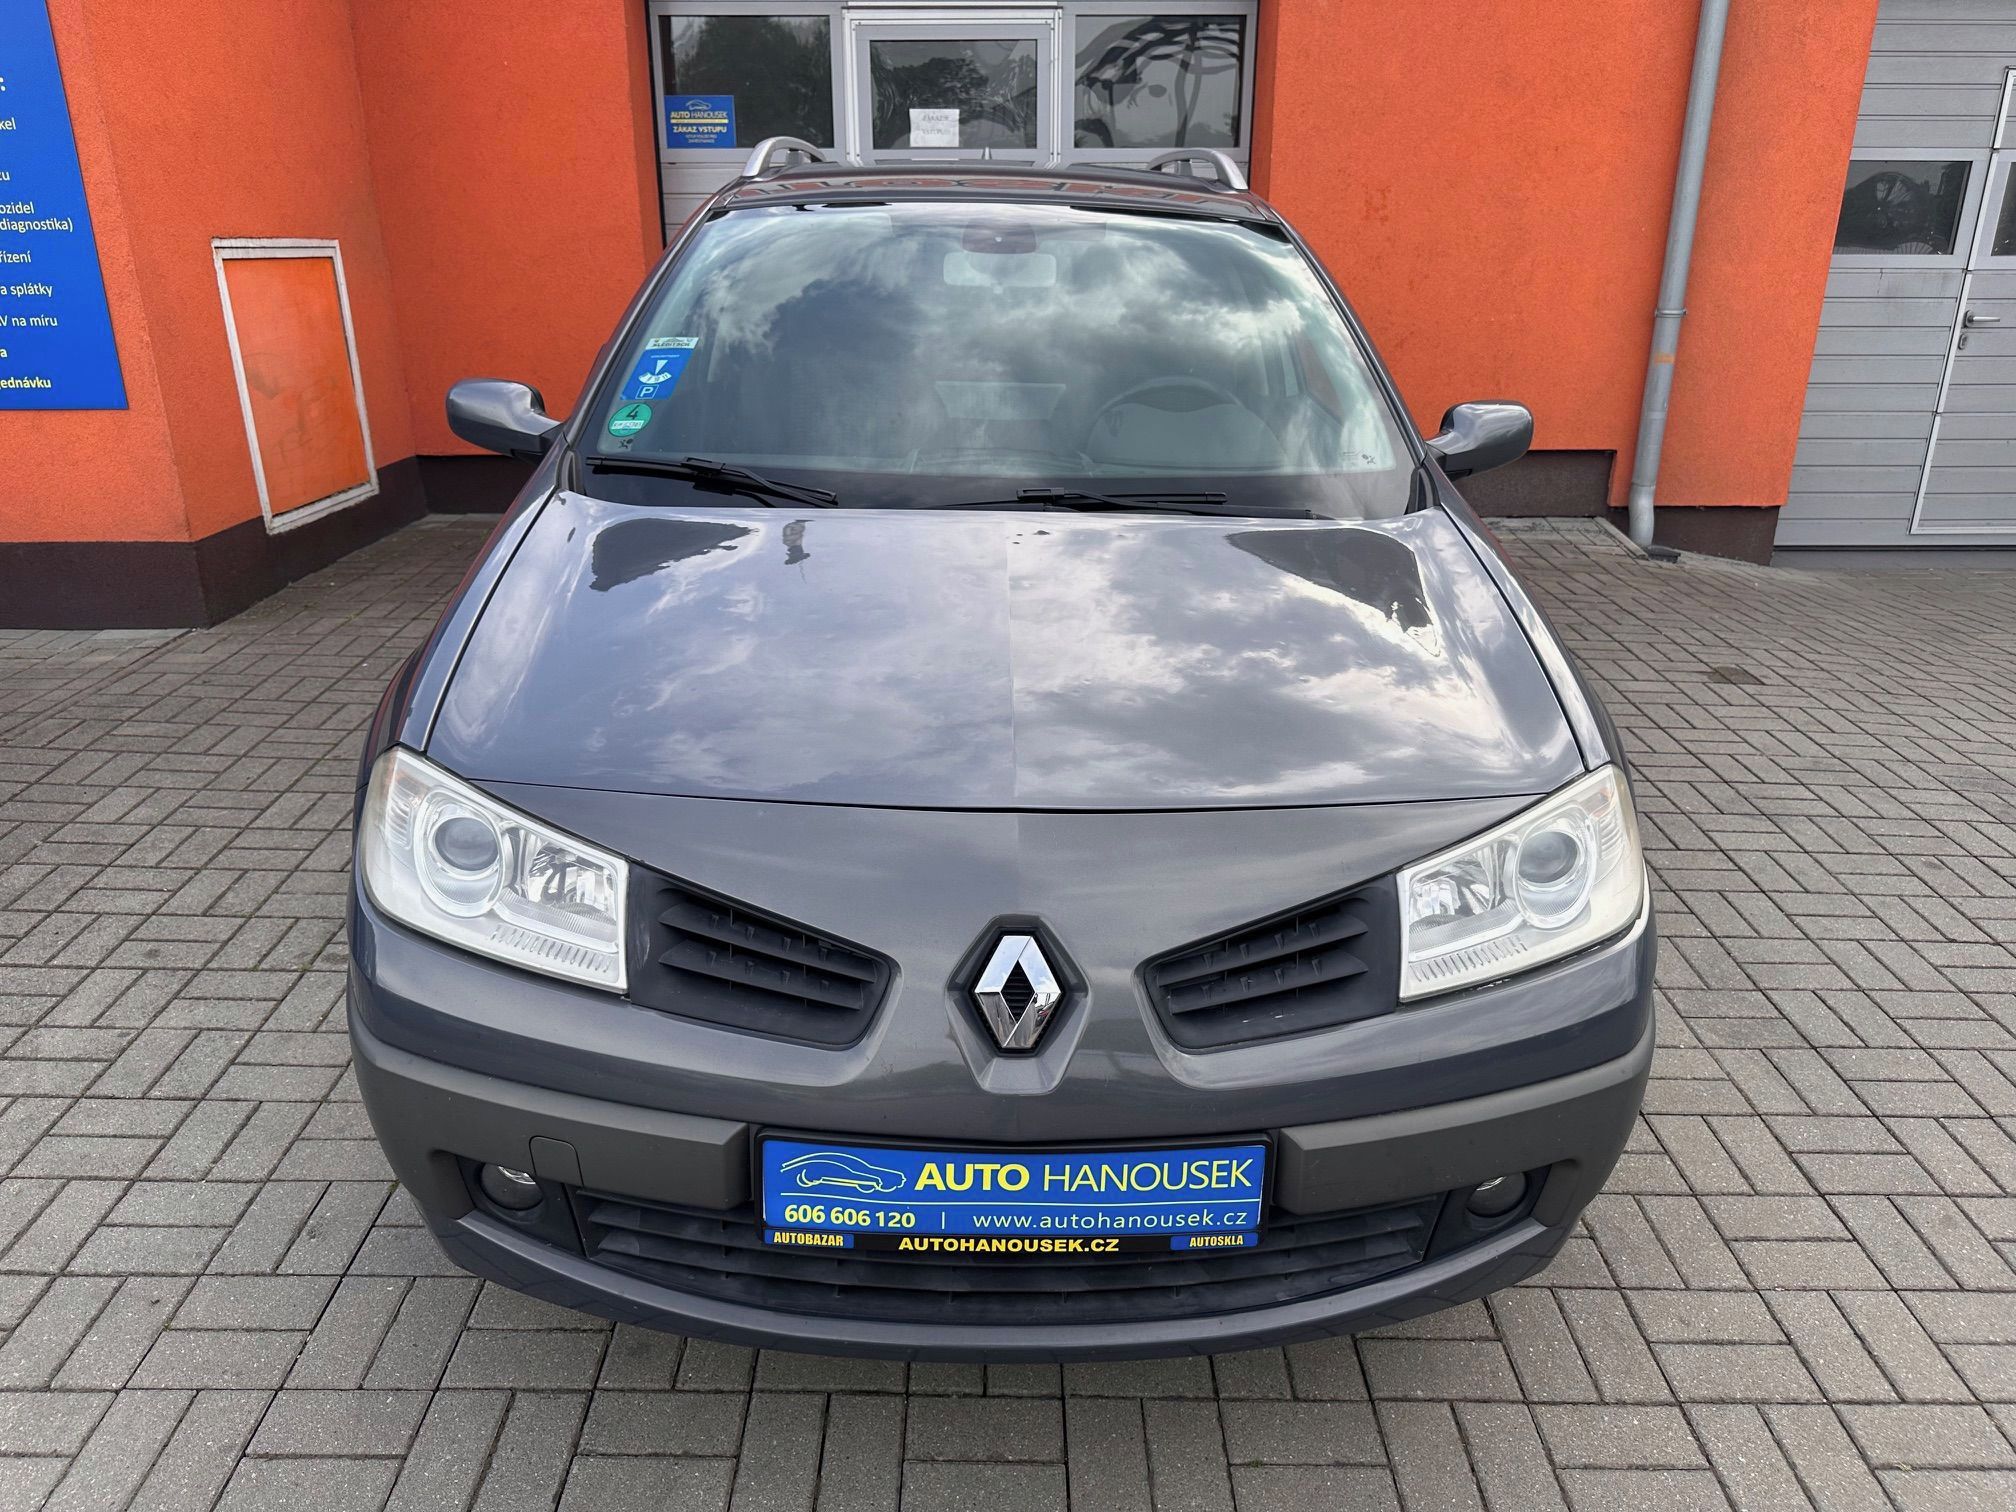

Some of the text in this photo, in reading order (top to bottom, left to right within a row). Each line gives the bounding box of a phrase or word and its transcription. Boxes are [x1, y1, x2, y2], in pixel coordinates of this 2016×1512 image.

[673, 125, 698, 133] ZÁKAZ
[0, 201, 35, 214] ozidel
[0, 217, 73, 233] diagnostika)
[10, 283, 53, 298] splátky
[12, 317, 27, 327] na
[30, 314, 58, 327] míru
[0, 376, 52, 390] ednávku
[640, 386, 654, 398] P
[626, 404, 640, 421] 4
[914, 1159, 1254, 1192] AUTO HANOUSEK
[784, 1204, 1248, 1230] 606 606 120 www.autohanousek.cz
[774, 1231, 1244, 1252] AUTOBAZAR AUTOHANOUSEK.CZ AUTOSKLA
